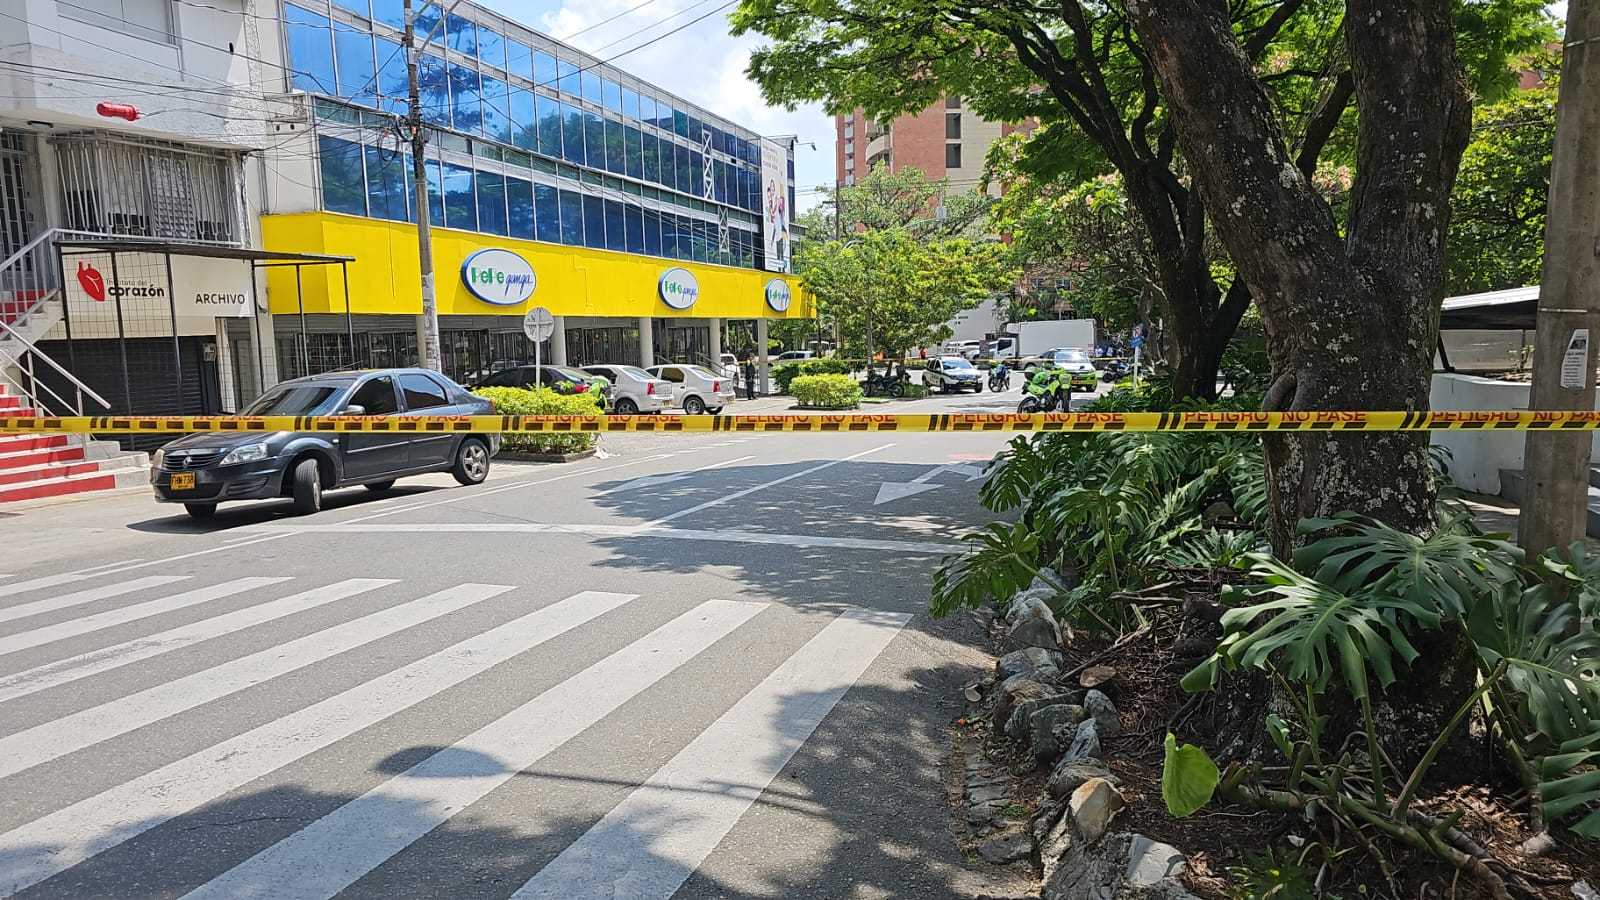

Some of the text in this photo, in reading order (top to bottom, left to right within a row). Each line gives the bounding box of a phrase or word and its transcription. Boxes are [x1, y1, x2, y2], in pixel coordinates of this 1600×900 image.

[195, 293, 246, 305] ARCHIVO
[952, 413, 1124, 424] PELIGRO NO PASE
[1184, 412, 1366, 422] PELIGRO NO PASE
[1431, 411, 1520, 422] PELIGRO
[1532, 411, 1564, 422] NO
